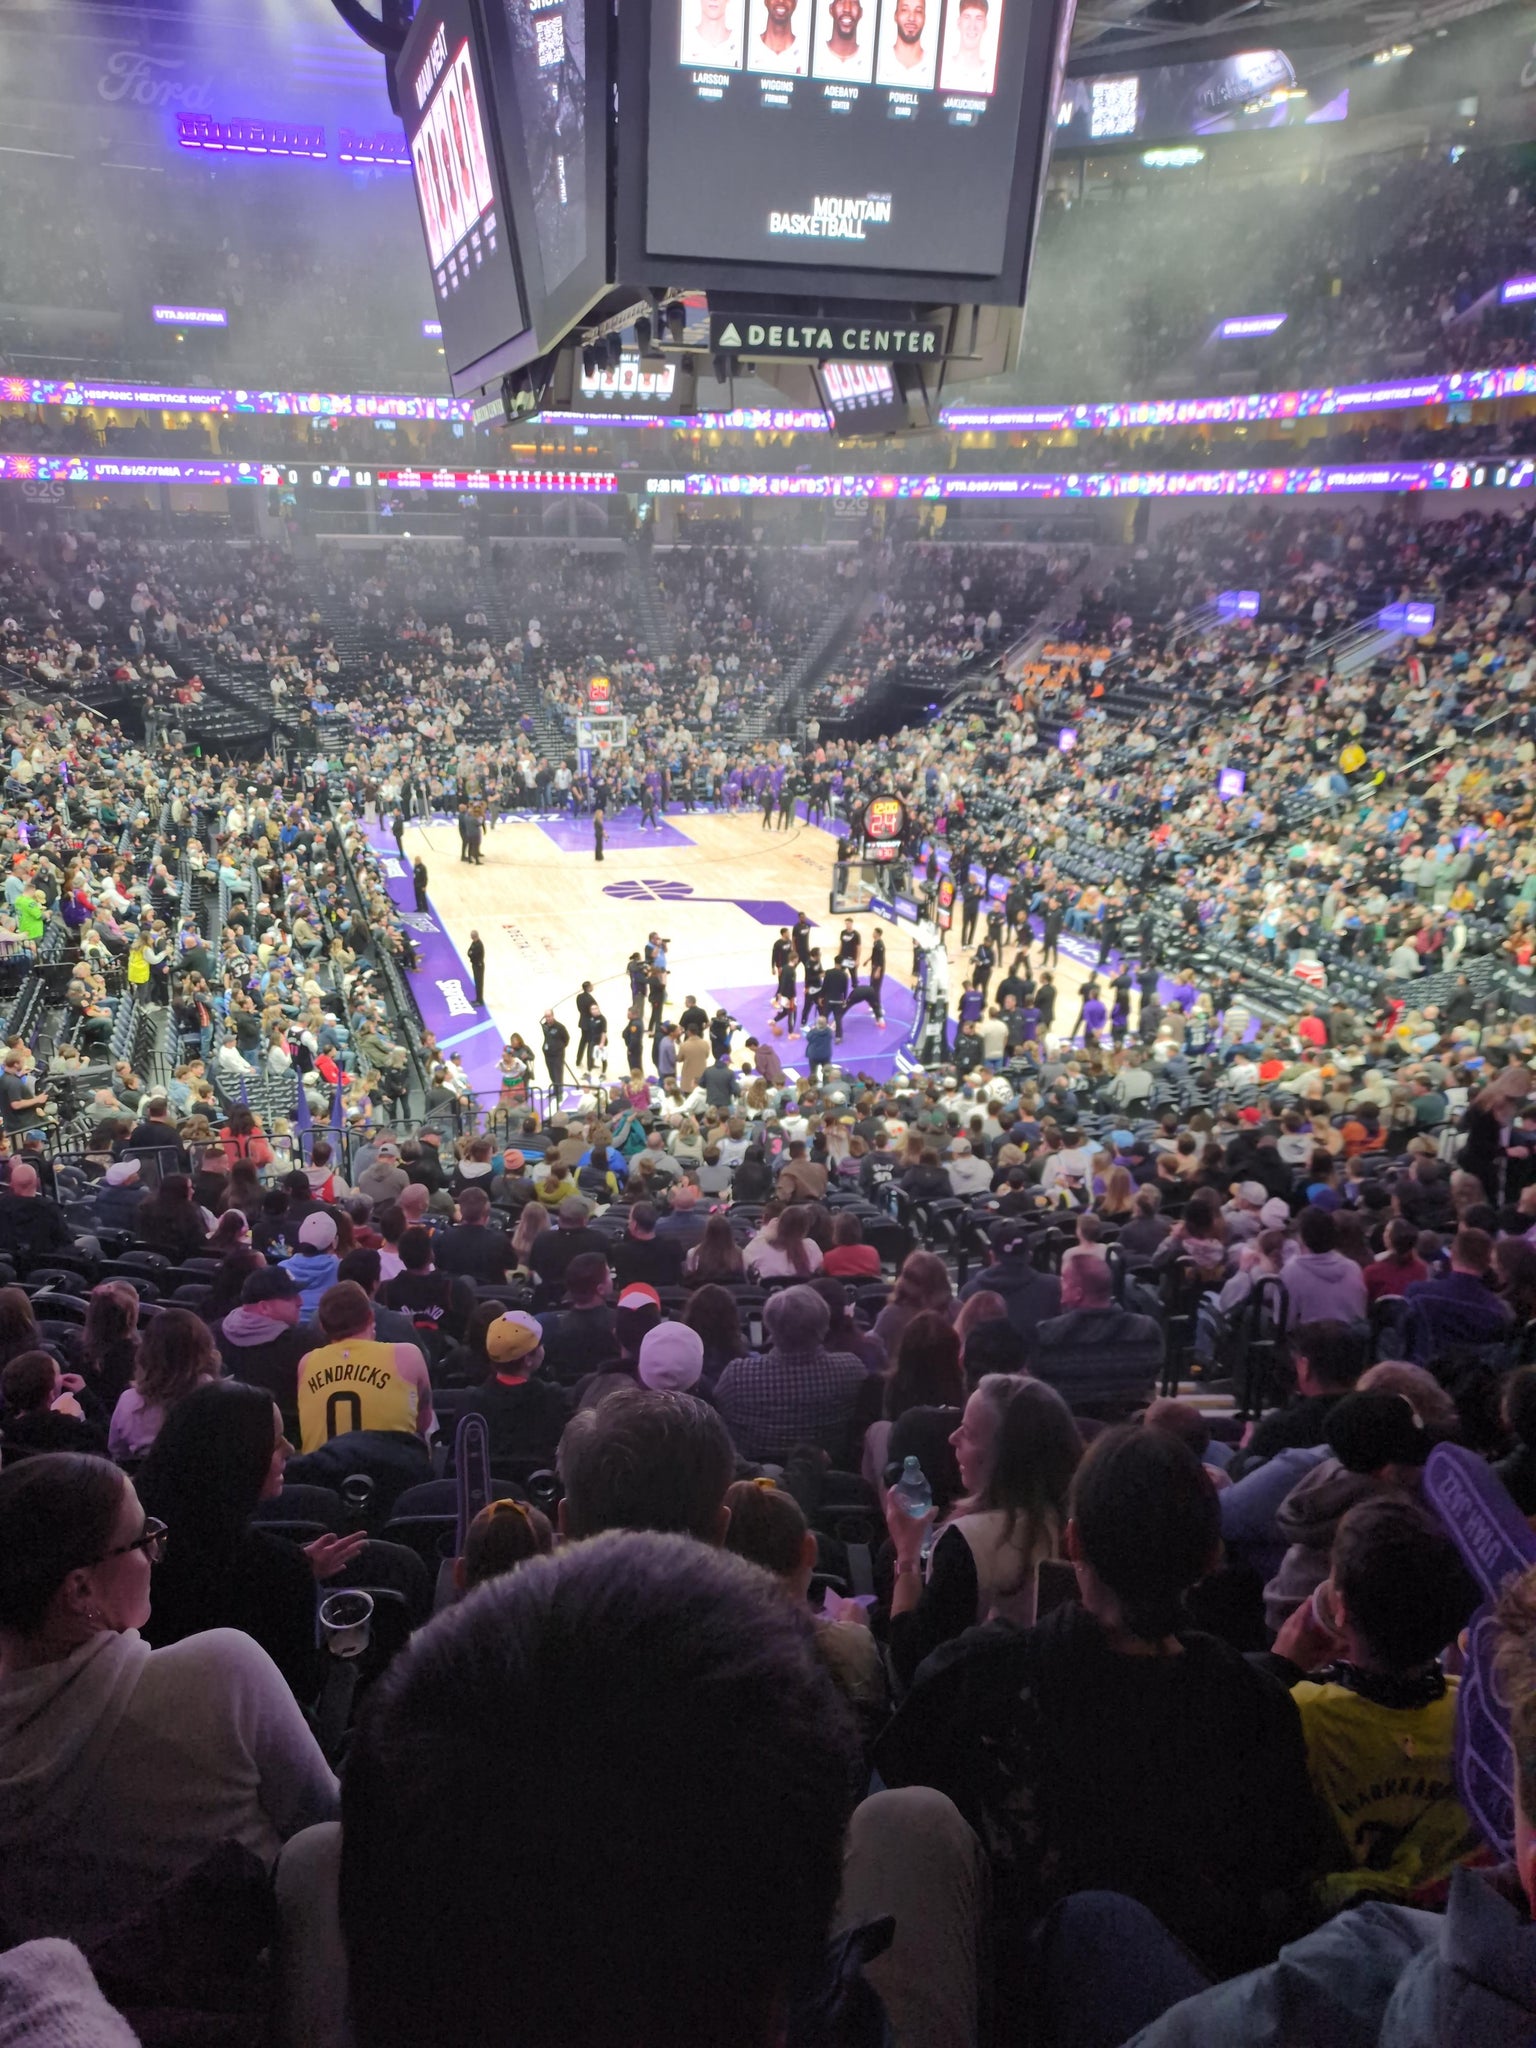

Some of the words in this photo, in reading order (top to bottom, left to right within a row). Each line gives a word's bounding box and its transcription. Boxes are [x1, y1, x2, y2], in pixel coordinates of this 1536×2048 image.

[97, 51, 214, 109] Ford
[693, 72, 729, 86] LARSSON
[761, 79, 793, 92] WIGGINS
[825, 85, 858, 99] ADEBAYO
[889, 92, 918, 104] POWELL
[814, 197, 891, 222] MOUNTAIN
[769, 212, 866, 239] BASKETBALL
[748, 325, 833, 349] DELTA
[843, 329, 935, 353] CENTER
[871, 815, 897, 834] 24
[307, 1363, 391, 1394] HENDRICKS
[326, 1390, 362, 1440] 0
